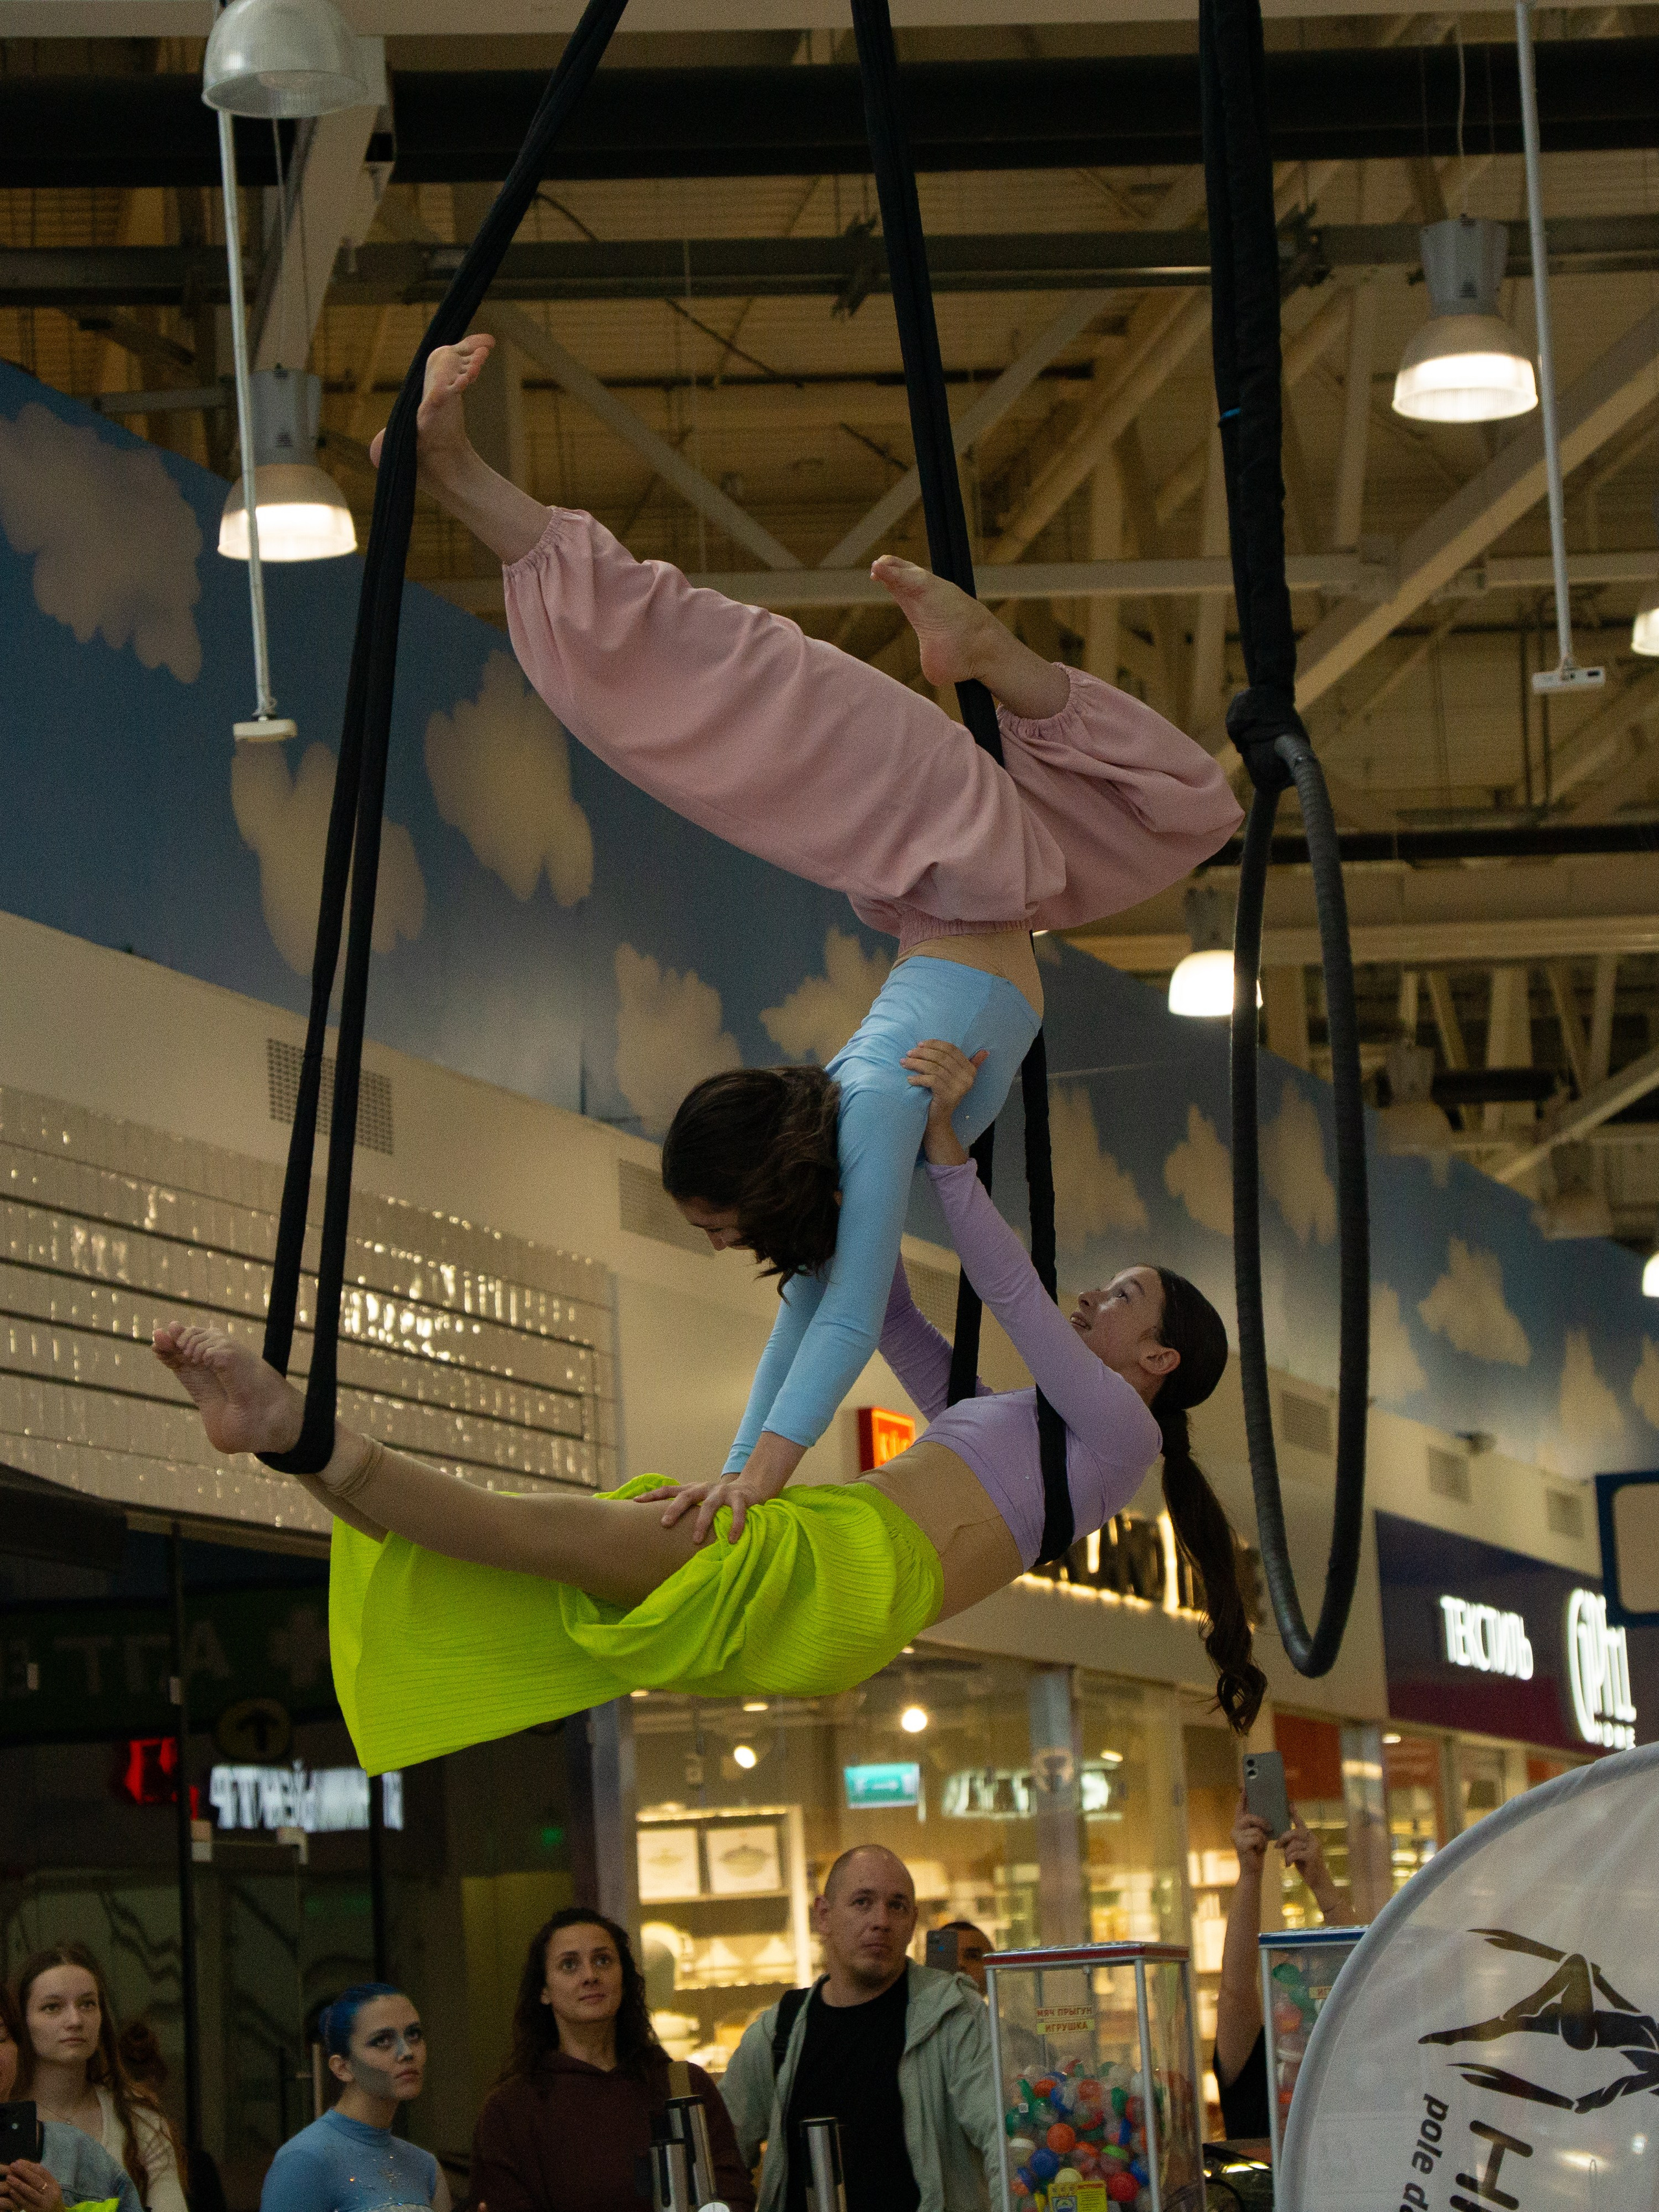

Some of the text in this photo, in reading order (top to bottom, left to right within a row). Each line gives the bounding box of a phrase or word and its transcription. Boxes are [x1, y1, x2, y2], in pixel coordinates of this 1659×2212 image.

[1440, 1595, 1534, 1681] ТЕКСТИЛЬ
[1045, 2021, 1088, 2032] ИГРУШКА
[1057, 2007, 1092, 2016] ПРЫГУН
[1411, 2093, 1449, 2174] pole
